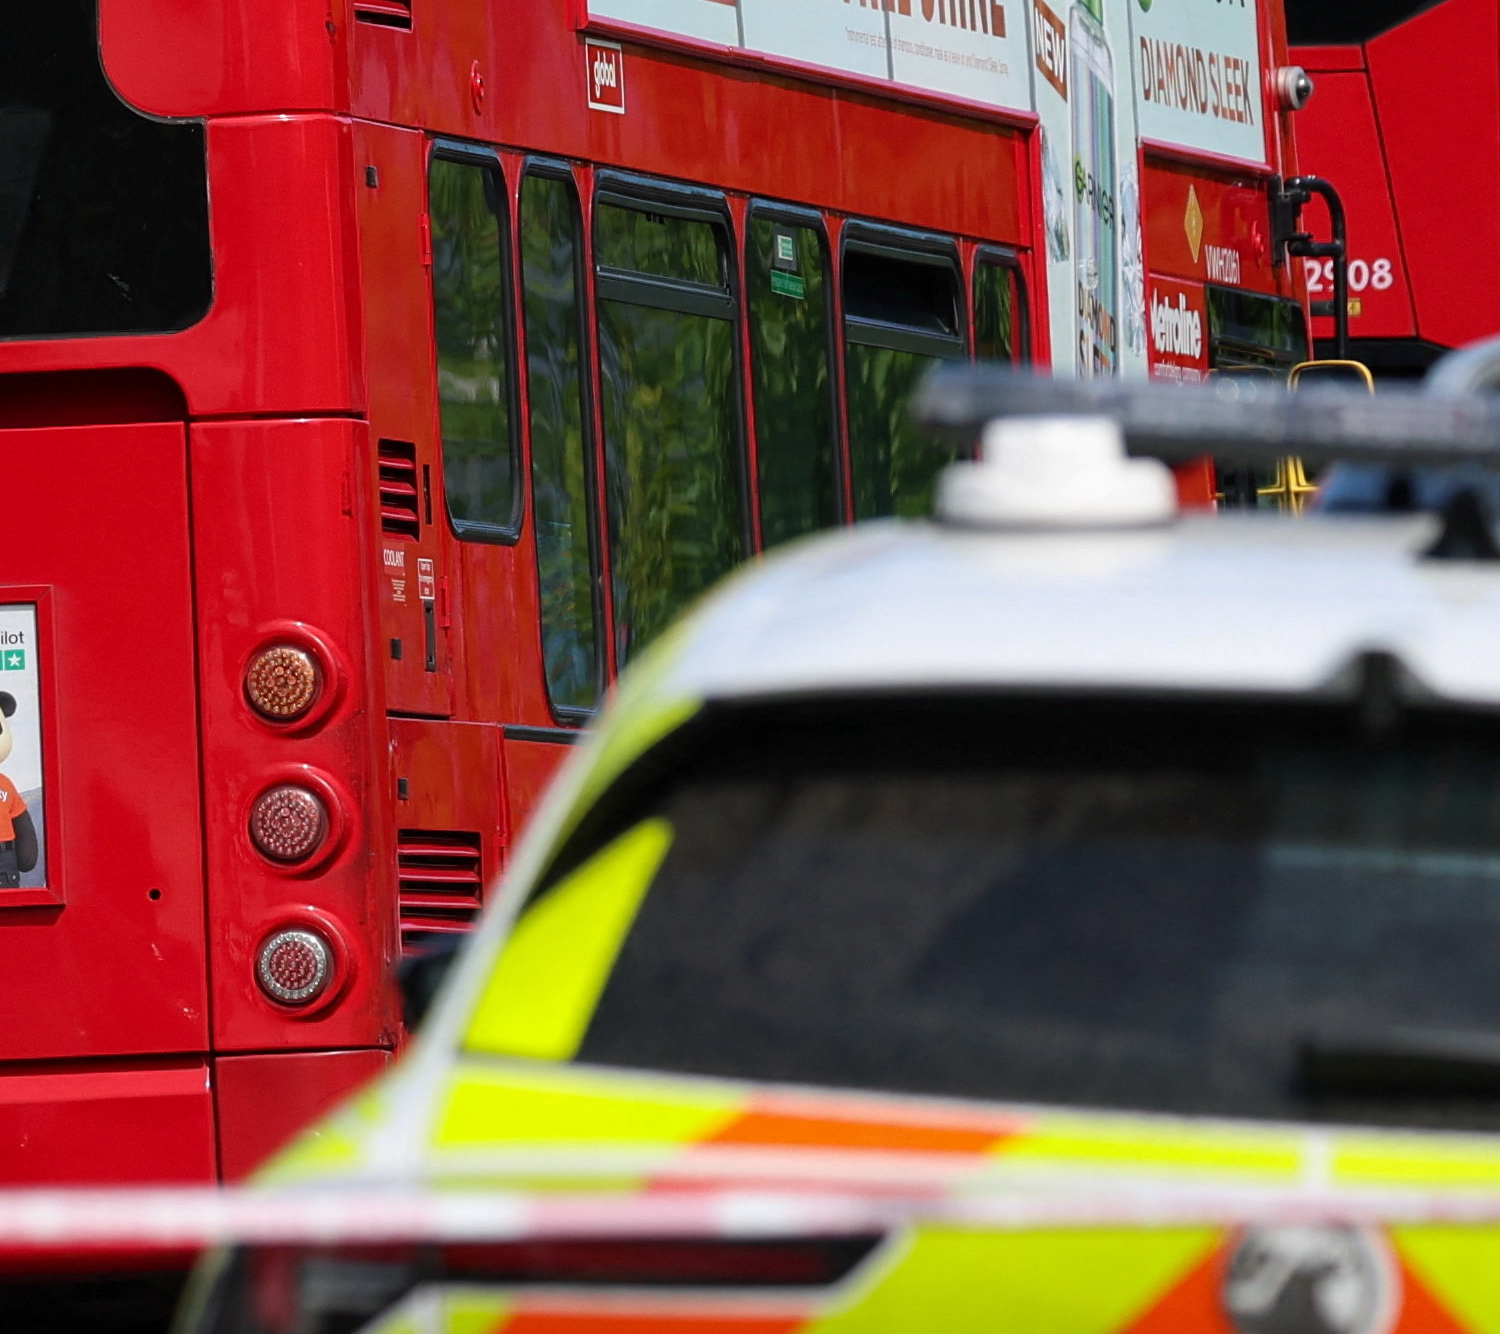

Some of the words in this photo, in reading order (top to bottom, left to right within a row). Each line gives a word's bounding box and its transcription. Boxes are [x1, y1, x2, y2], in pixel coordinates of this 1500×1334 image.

[593, 50, 617, 99] global
[1034, 7, 1065, 84] NEW
[1139, 35, 1208, 115] DIAMOND
[1208, 51, 1254, 126] SLEEK
[1204, 244, 1241, 284] VWH2061
